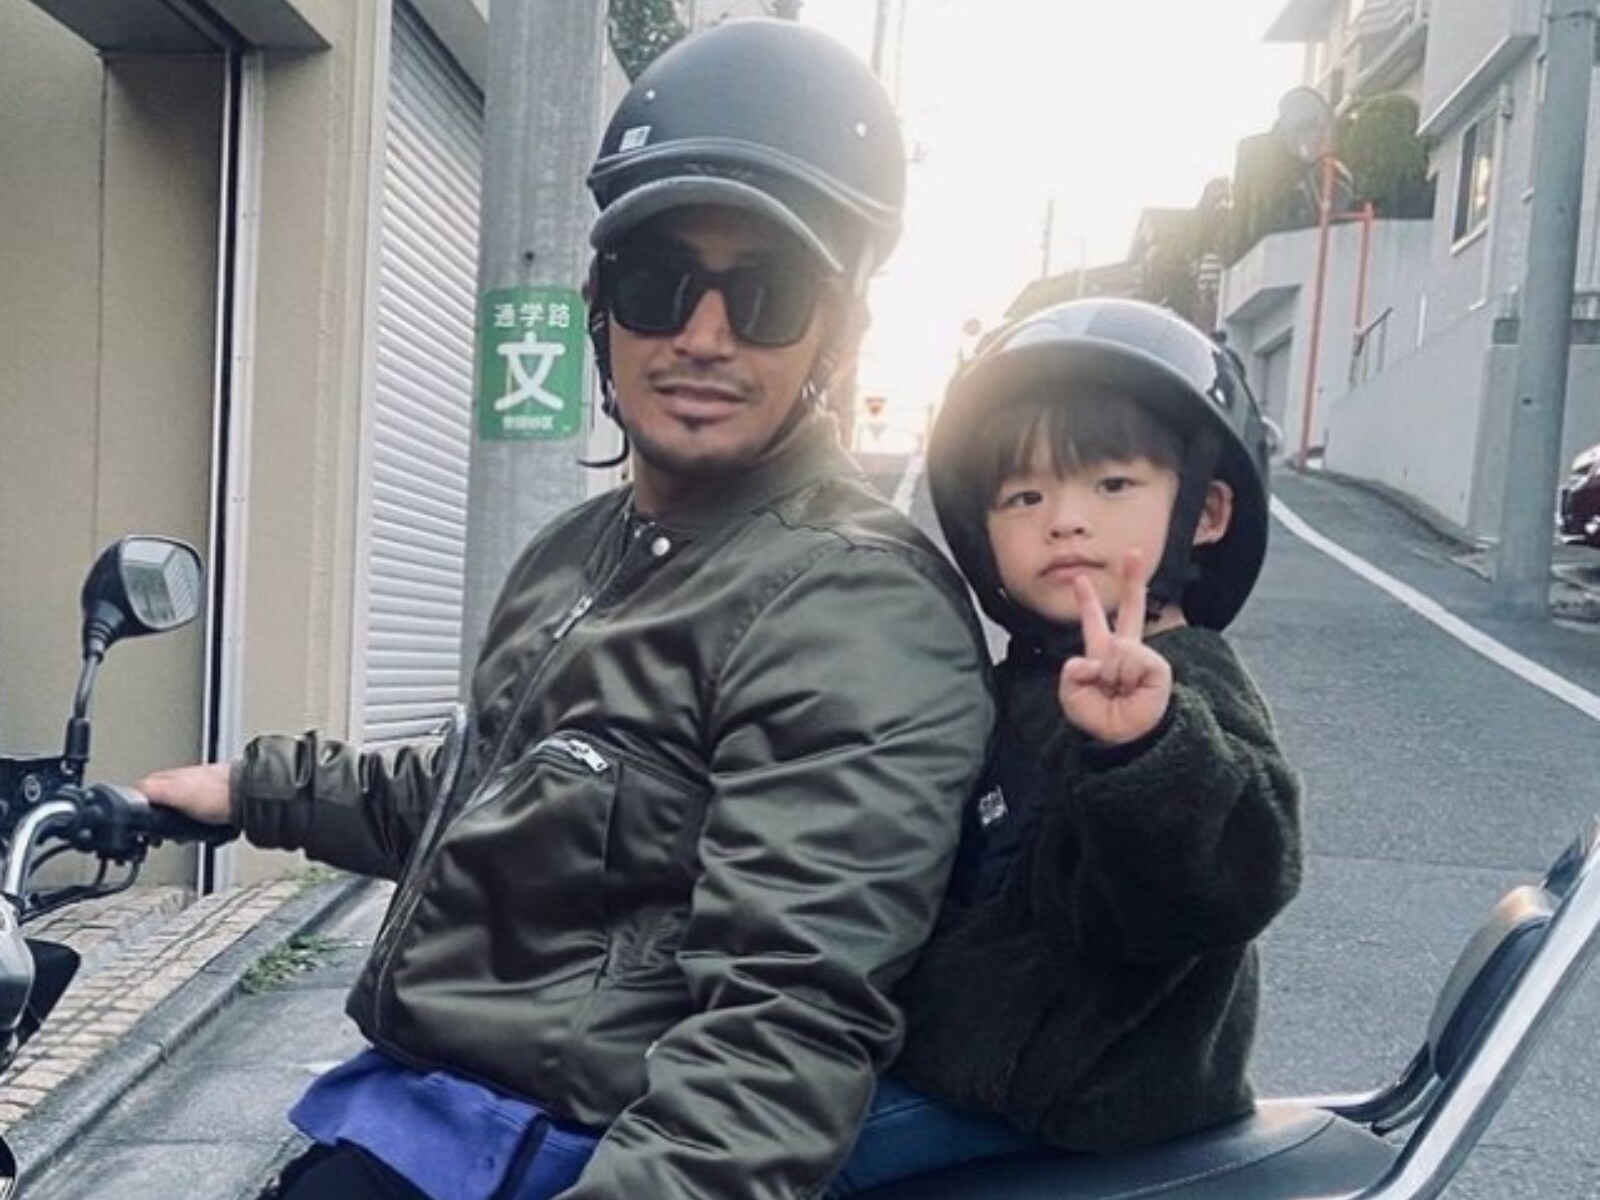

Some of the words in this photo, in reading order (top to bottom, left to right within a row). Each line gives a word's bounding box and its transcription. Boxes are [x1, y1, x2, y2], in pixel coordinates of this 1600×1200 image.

[494, 303, 571, 328] 通学路
[494, 331, 566, 411] 文
